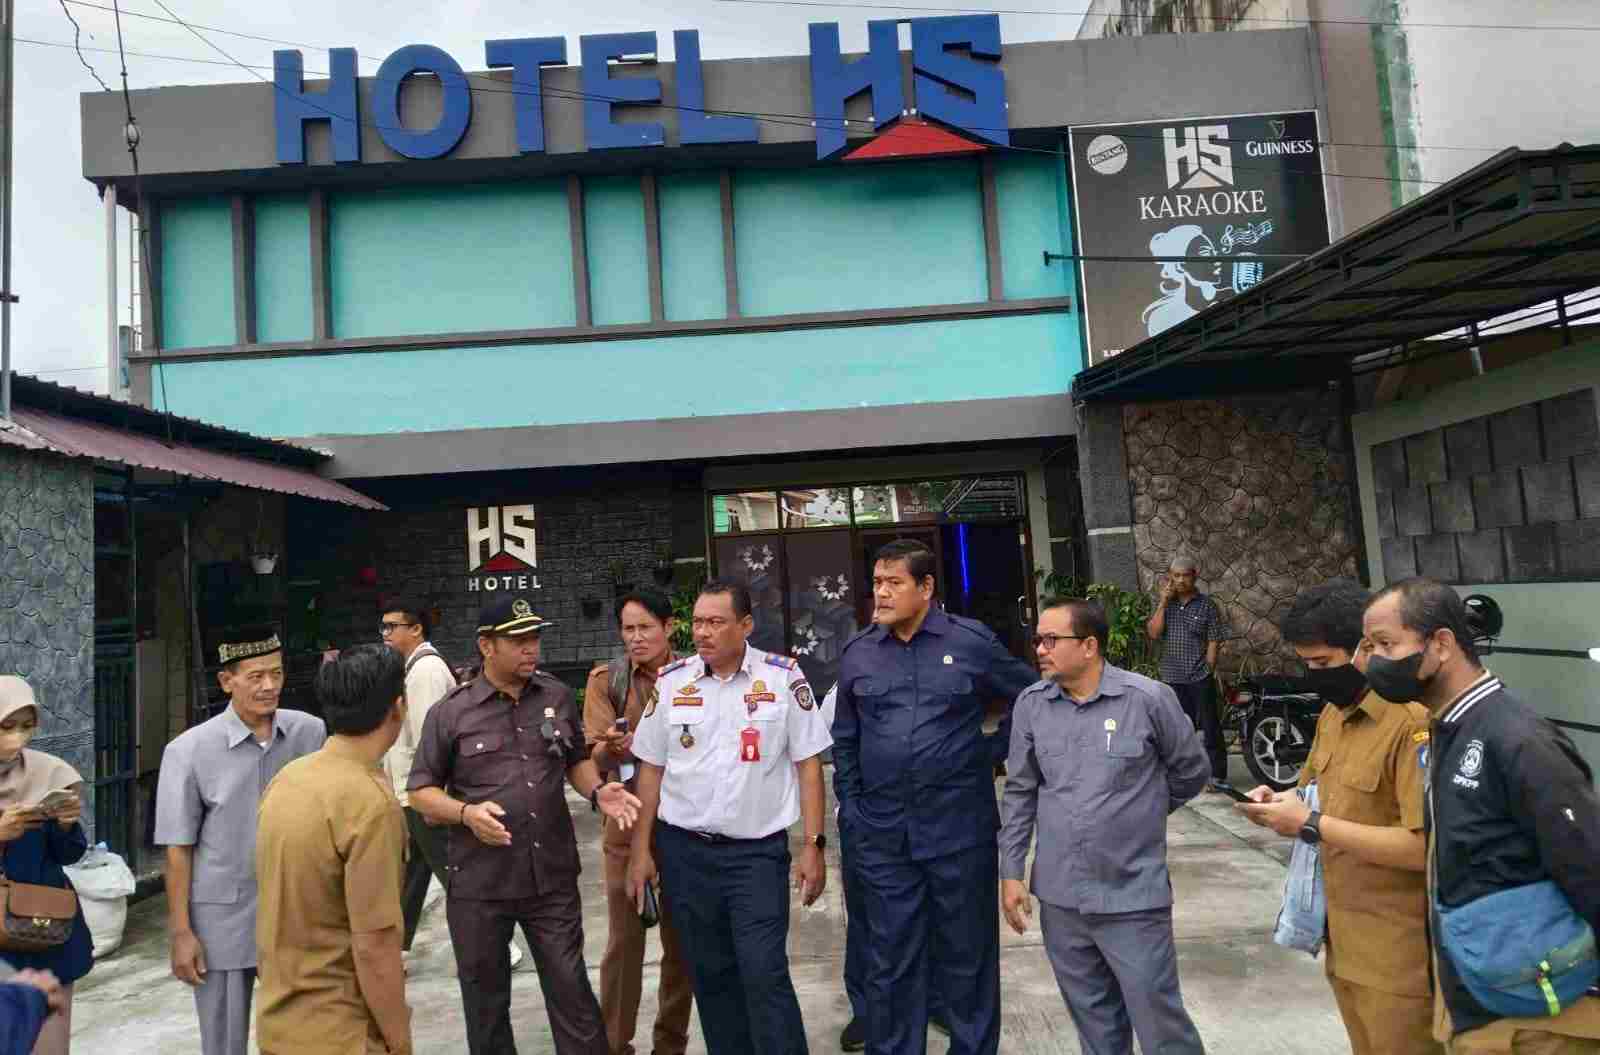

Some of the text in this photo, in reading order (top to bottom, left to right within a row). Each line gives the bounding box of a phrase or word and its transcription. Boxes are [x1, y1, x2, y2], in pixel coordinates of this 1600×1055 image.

[273, 14, 1009, 163] HOTEL HS
[1162, 125, 1234, 190] HS
[1246, 139, 1314, 157] GUINNESS
[1138, 190, 1267, 220] KARAOKE
[467, 504, 537, 572] HS
[468, 575, 542, 592] HOTEL
